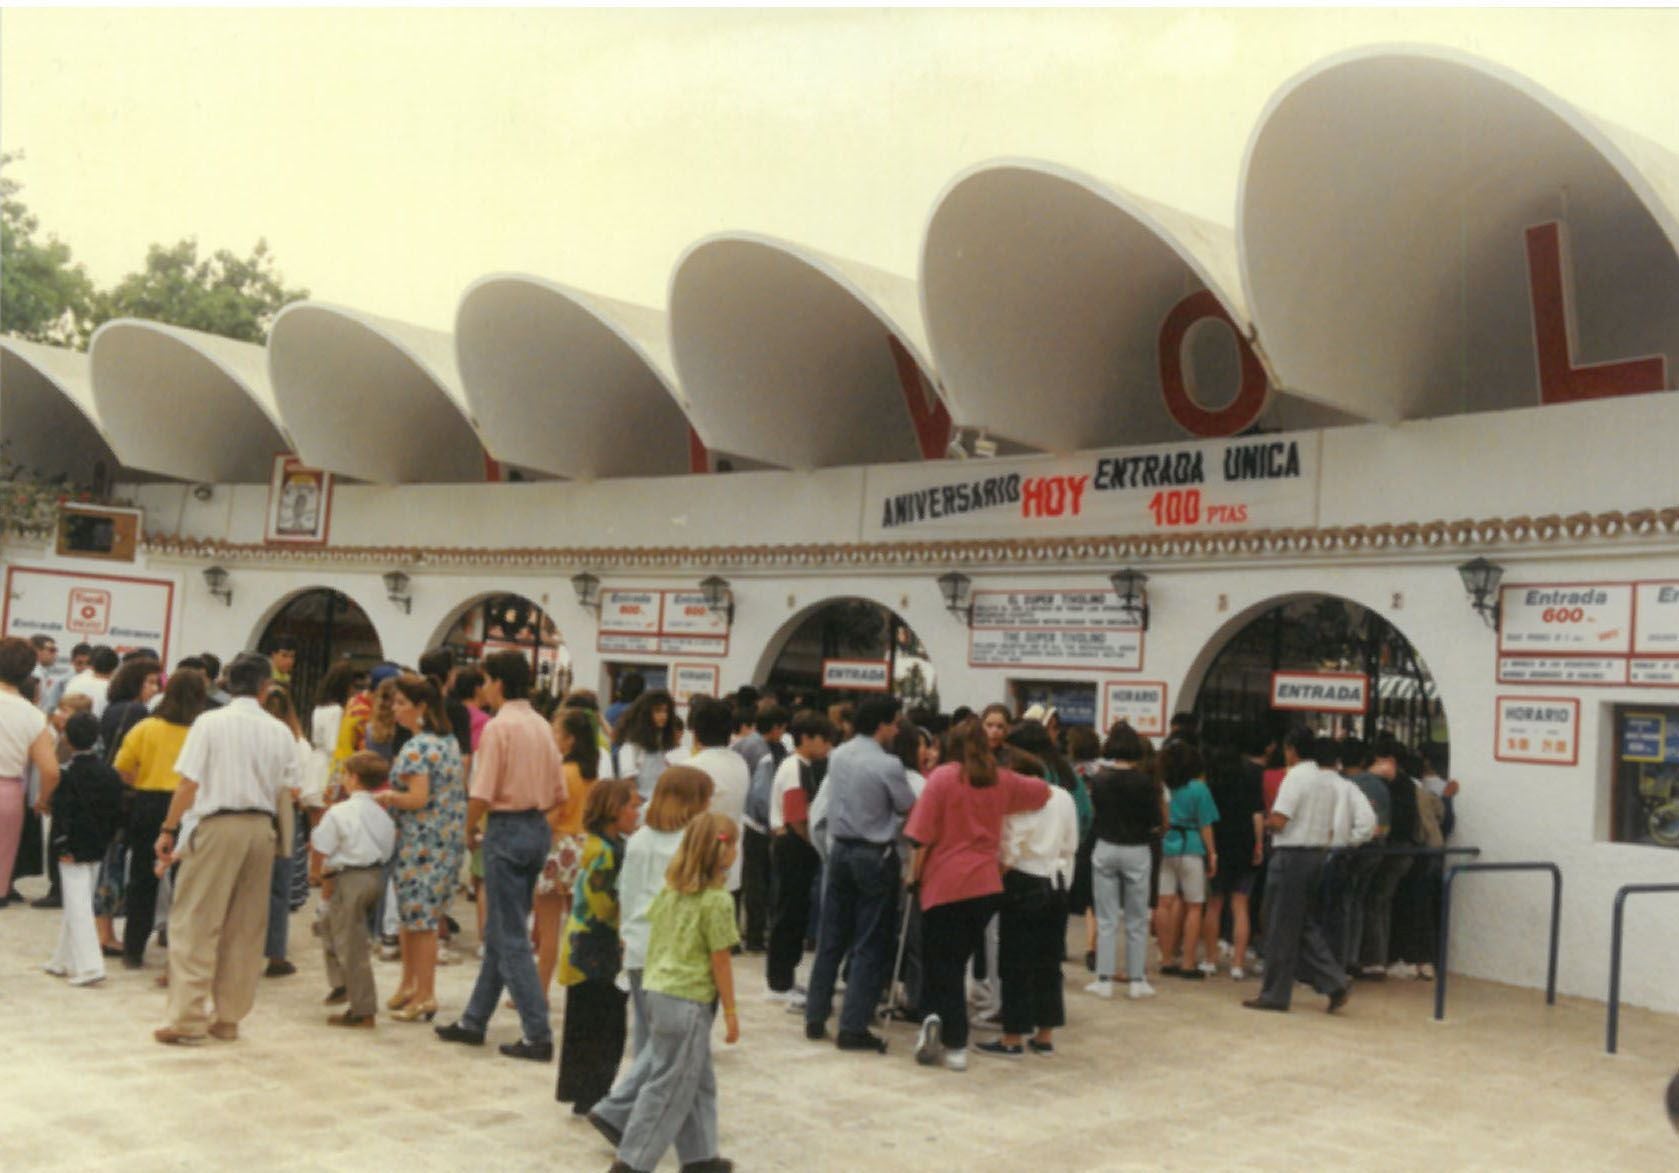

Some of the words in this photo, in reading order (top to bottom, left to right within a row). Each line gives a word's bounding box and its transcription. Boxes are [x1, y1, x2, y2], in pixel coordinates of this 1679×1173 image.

[1524, 221, 1667, 405] L
[882, 473, 1020, 528] ANIVERSARIO
[1021, 474, 1090, 518] HOY
[1094, 450, 1204, 490] ENTRADA
[1223, 441, 1300, 481] UNICA
[1148, 489, 1200, 526] 100
[1206, 504, 1248, 524] PTAS
[1525, 588, 1607, 606] Entrada
[1542, 607, 1584, 624] 600
[828, 666, 885, 680] ENTRADA
[1112, 689, 1158, 702] HORARIO
[1278, 682, 1360, 700] ENTRADA
[1505, 706, 1570, 723] HORARIO
